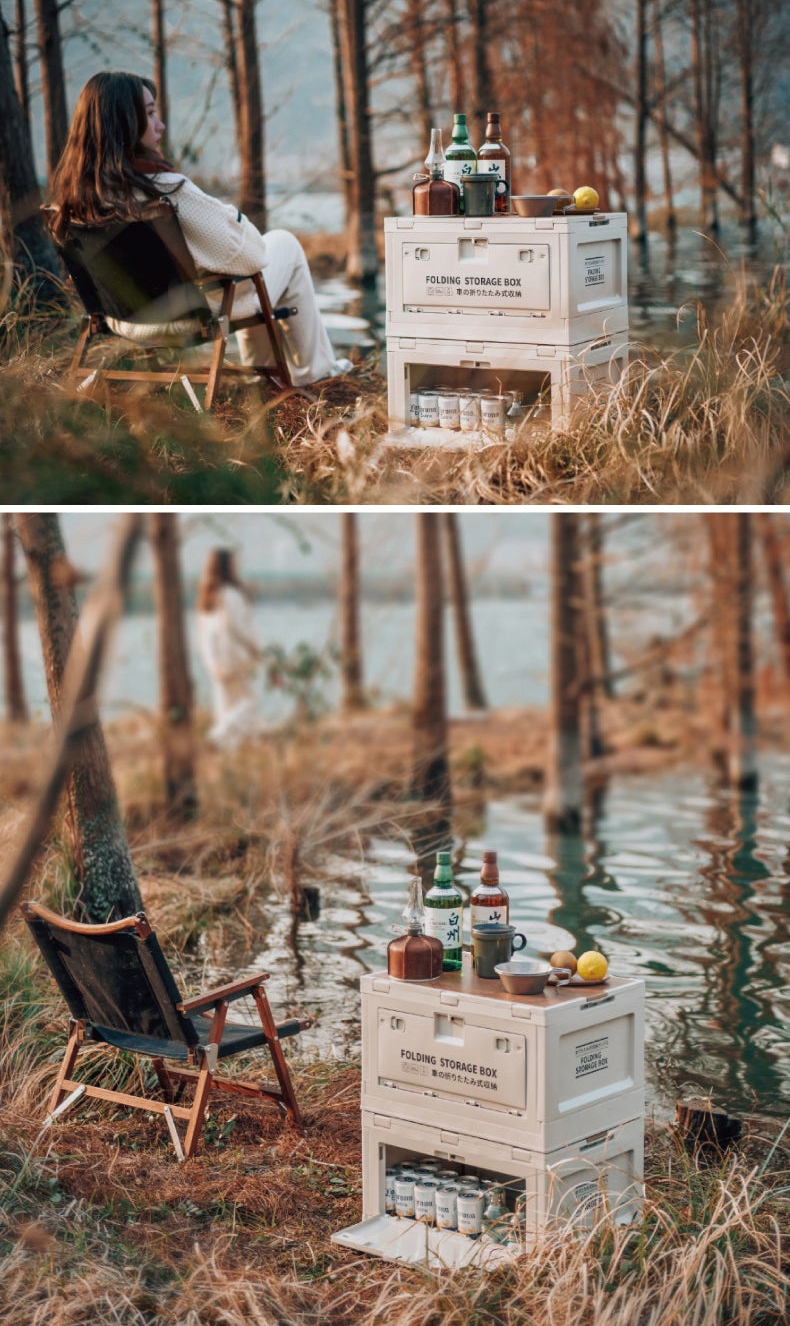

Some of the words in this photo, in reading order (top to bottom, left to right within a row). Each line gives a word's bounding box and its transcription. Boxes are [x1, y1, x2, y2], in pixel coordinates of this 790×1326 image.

[425, 275, 461, 285] FOLDING
[464, 276, 502, 286] STORAGE
[504, 278, 522, 287] BOX
[400, 1049, 437, 1065] FOLDING
[440, 1057, 478, 1075] STORAGE
[479, 1065, 498, 1079] BOX
